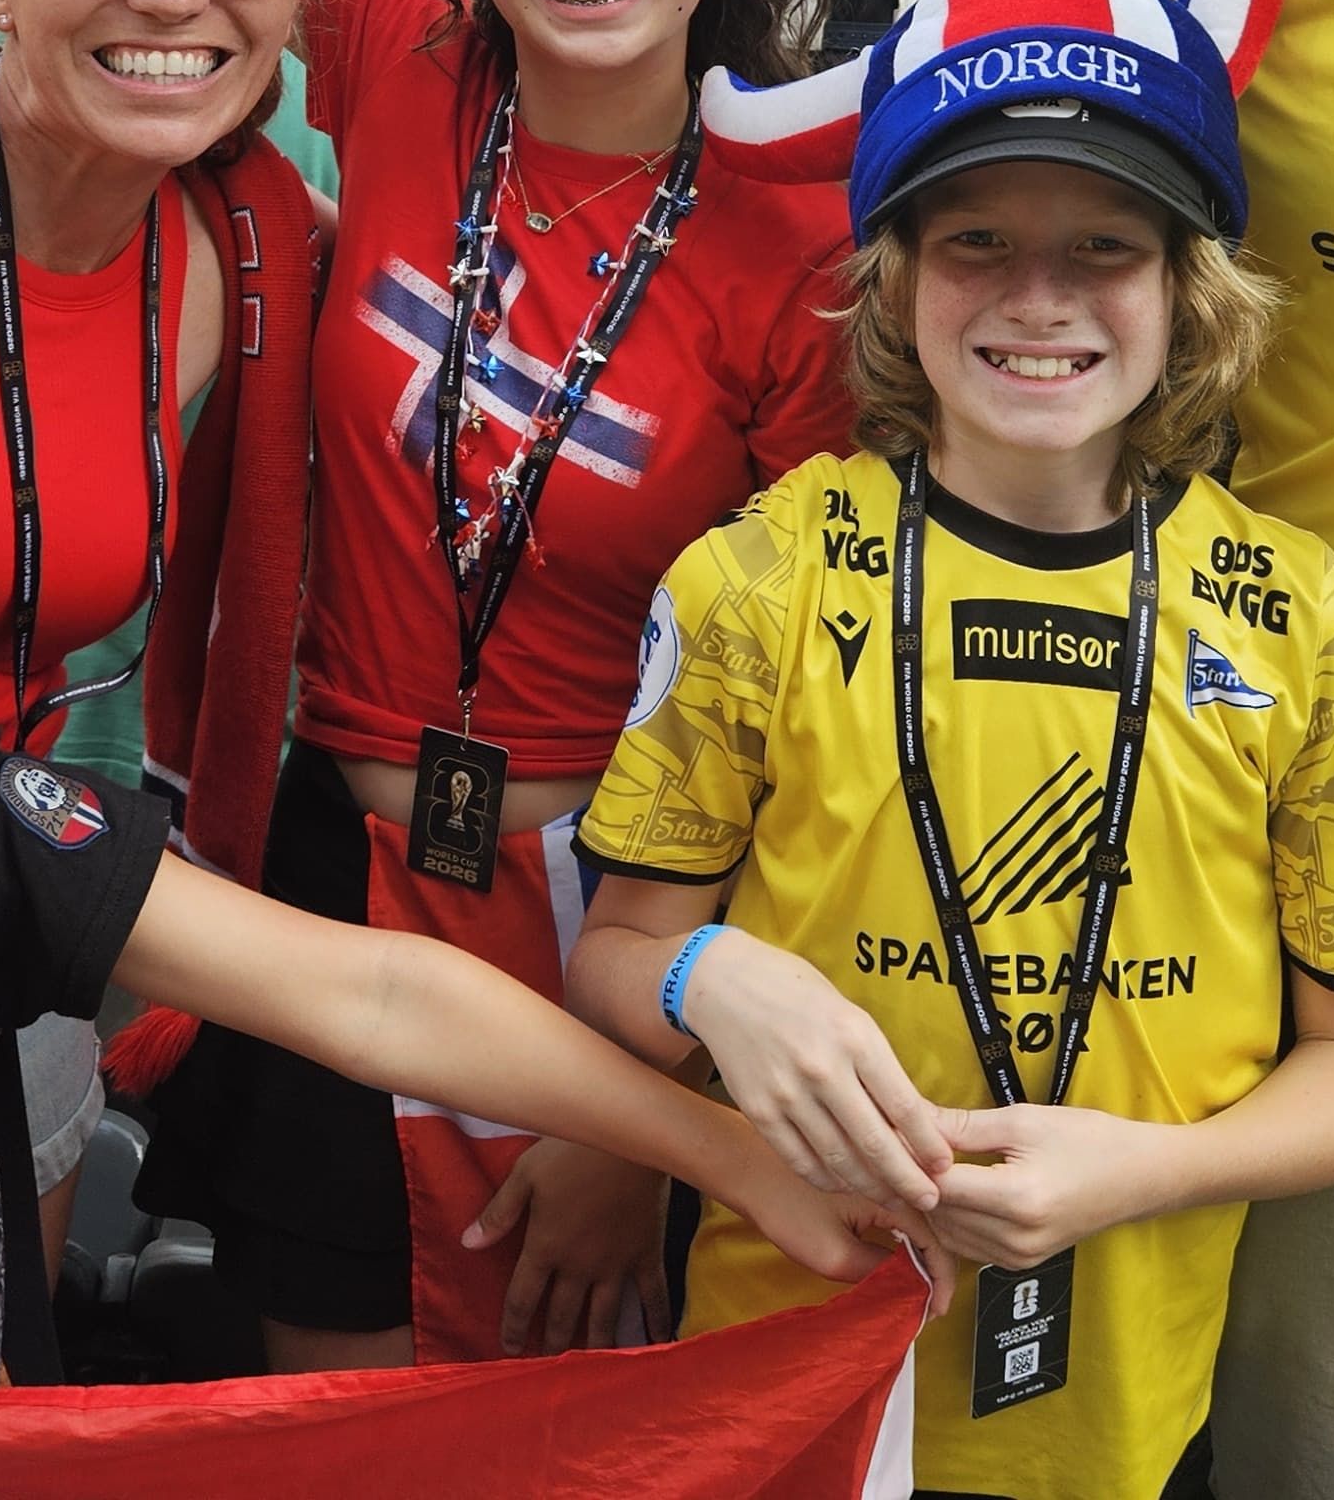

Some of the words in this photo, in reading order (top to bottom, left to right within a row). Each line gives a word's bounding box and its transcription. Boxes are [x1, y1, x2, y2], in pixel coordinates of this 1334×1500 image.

[933, 40, 1142, 112] NORGE
[904, 545, 914, 574] WORLD
[964, 619, 1121, 670] murisør
[1134, 655, 1145, 687] WORLD
[903, 681, 913, 713] WORLD
[1112, 793, 1123, 826] WORLD
[923, 819, 938, 852] WORLD
[423, 856, 479, 884] 2026
[426, 847, 459, 863] WORLD
[460, 857, 480, 870] CUP
[1085, 932, 1098, 965] WORLD
[663, 929, 708, 1007] TRANSIT
[856, 931, 1197, 1001] SPAEBANKEN
[958, 953, 975, 985] WORLD
